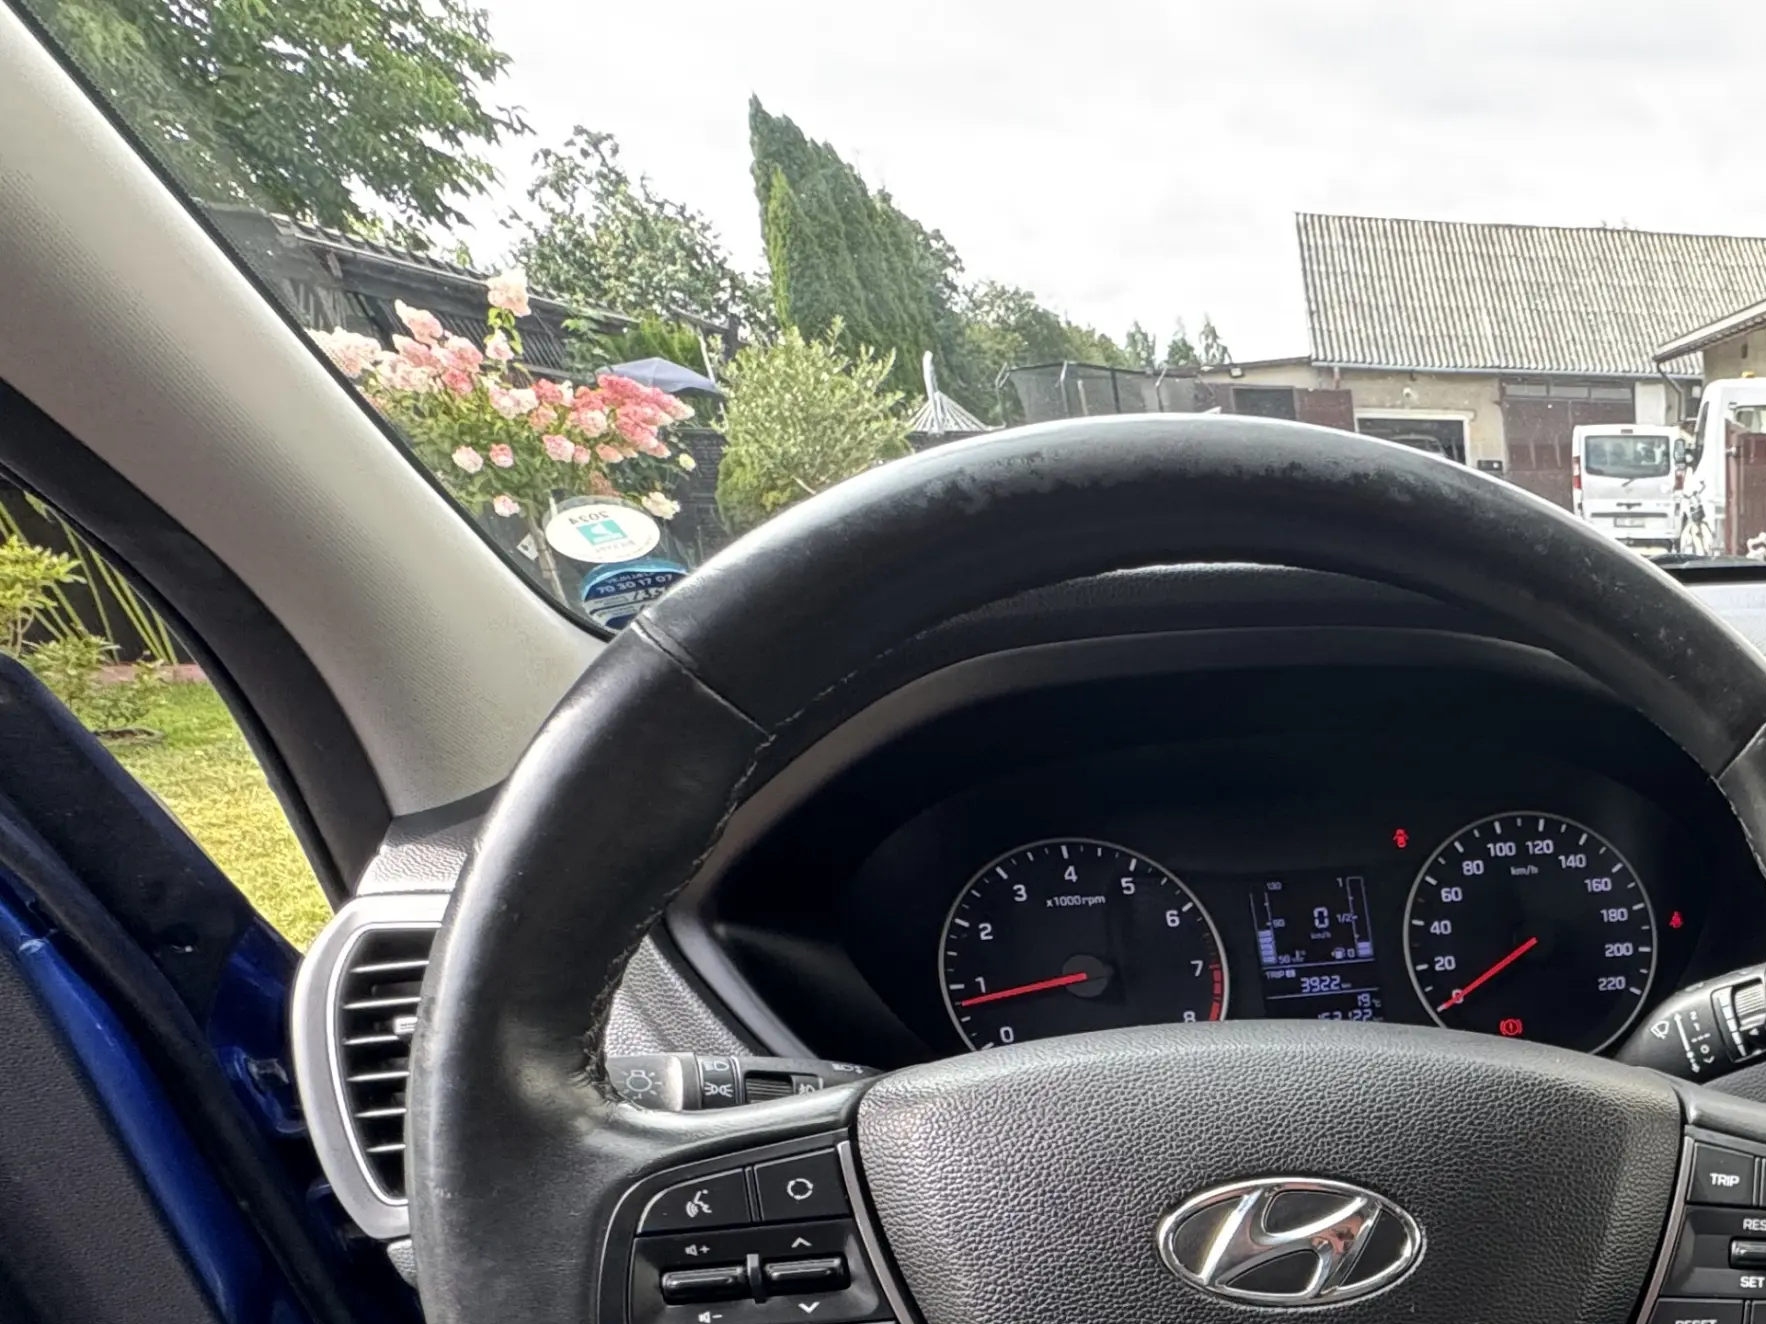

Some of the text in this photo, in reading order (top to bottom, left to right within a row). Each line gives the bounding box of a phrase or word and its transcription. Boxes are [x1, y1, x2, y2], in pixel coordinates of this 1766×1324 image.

[1487, 842, 1516, 857] 100
[1526, 840, 1554, 855] 120
[1462, 860, 1484, 875] 80
[1558, 854, 1587, 870] 140
[1064, 865, 1078, 882] 4
[1510, 865, 1539, 876] km/h
[1012, 884, 1028, 902] 3
[1120, 877, 1136, 895] 5
[1585, 878, 1612, 893] 160
[1441, 887, 1463, 902] 60
[1165, 910, 1180, 928] 6
[1313, 907, 1330, 929] 0
[1600, 907, 1628, 922] 180
[978, 923, 994, 940] 2
[1430, 920, 1452, 935] 40
[1605, 943, 1633, 957] 200
[1190, 960, 1204, 977] 7
[1434, 956, 1456, 971] 20
[975, 977, 987, 993] 1
[1300, 975, 1341, 993] 3922
[1598, 976, 1626, 991] 220
[1000, 1026, 1014, 1043] 0
[1710, 1172, 1740, 1187] TRIP
